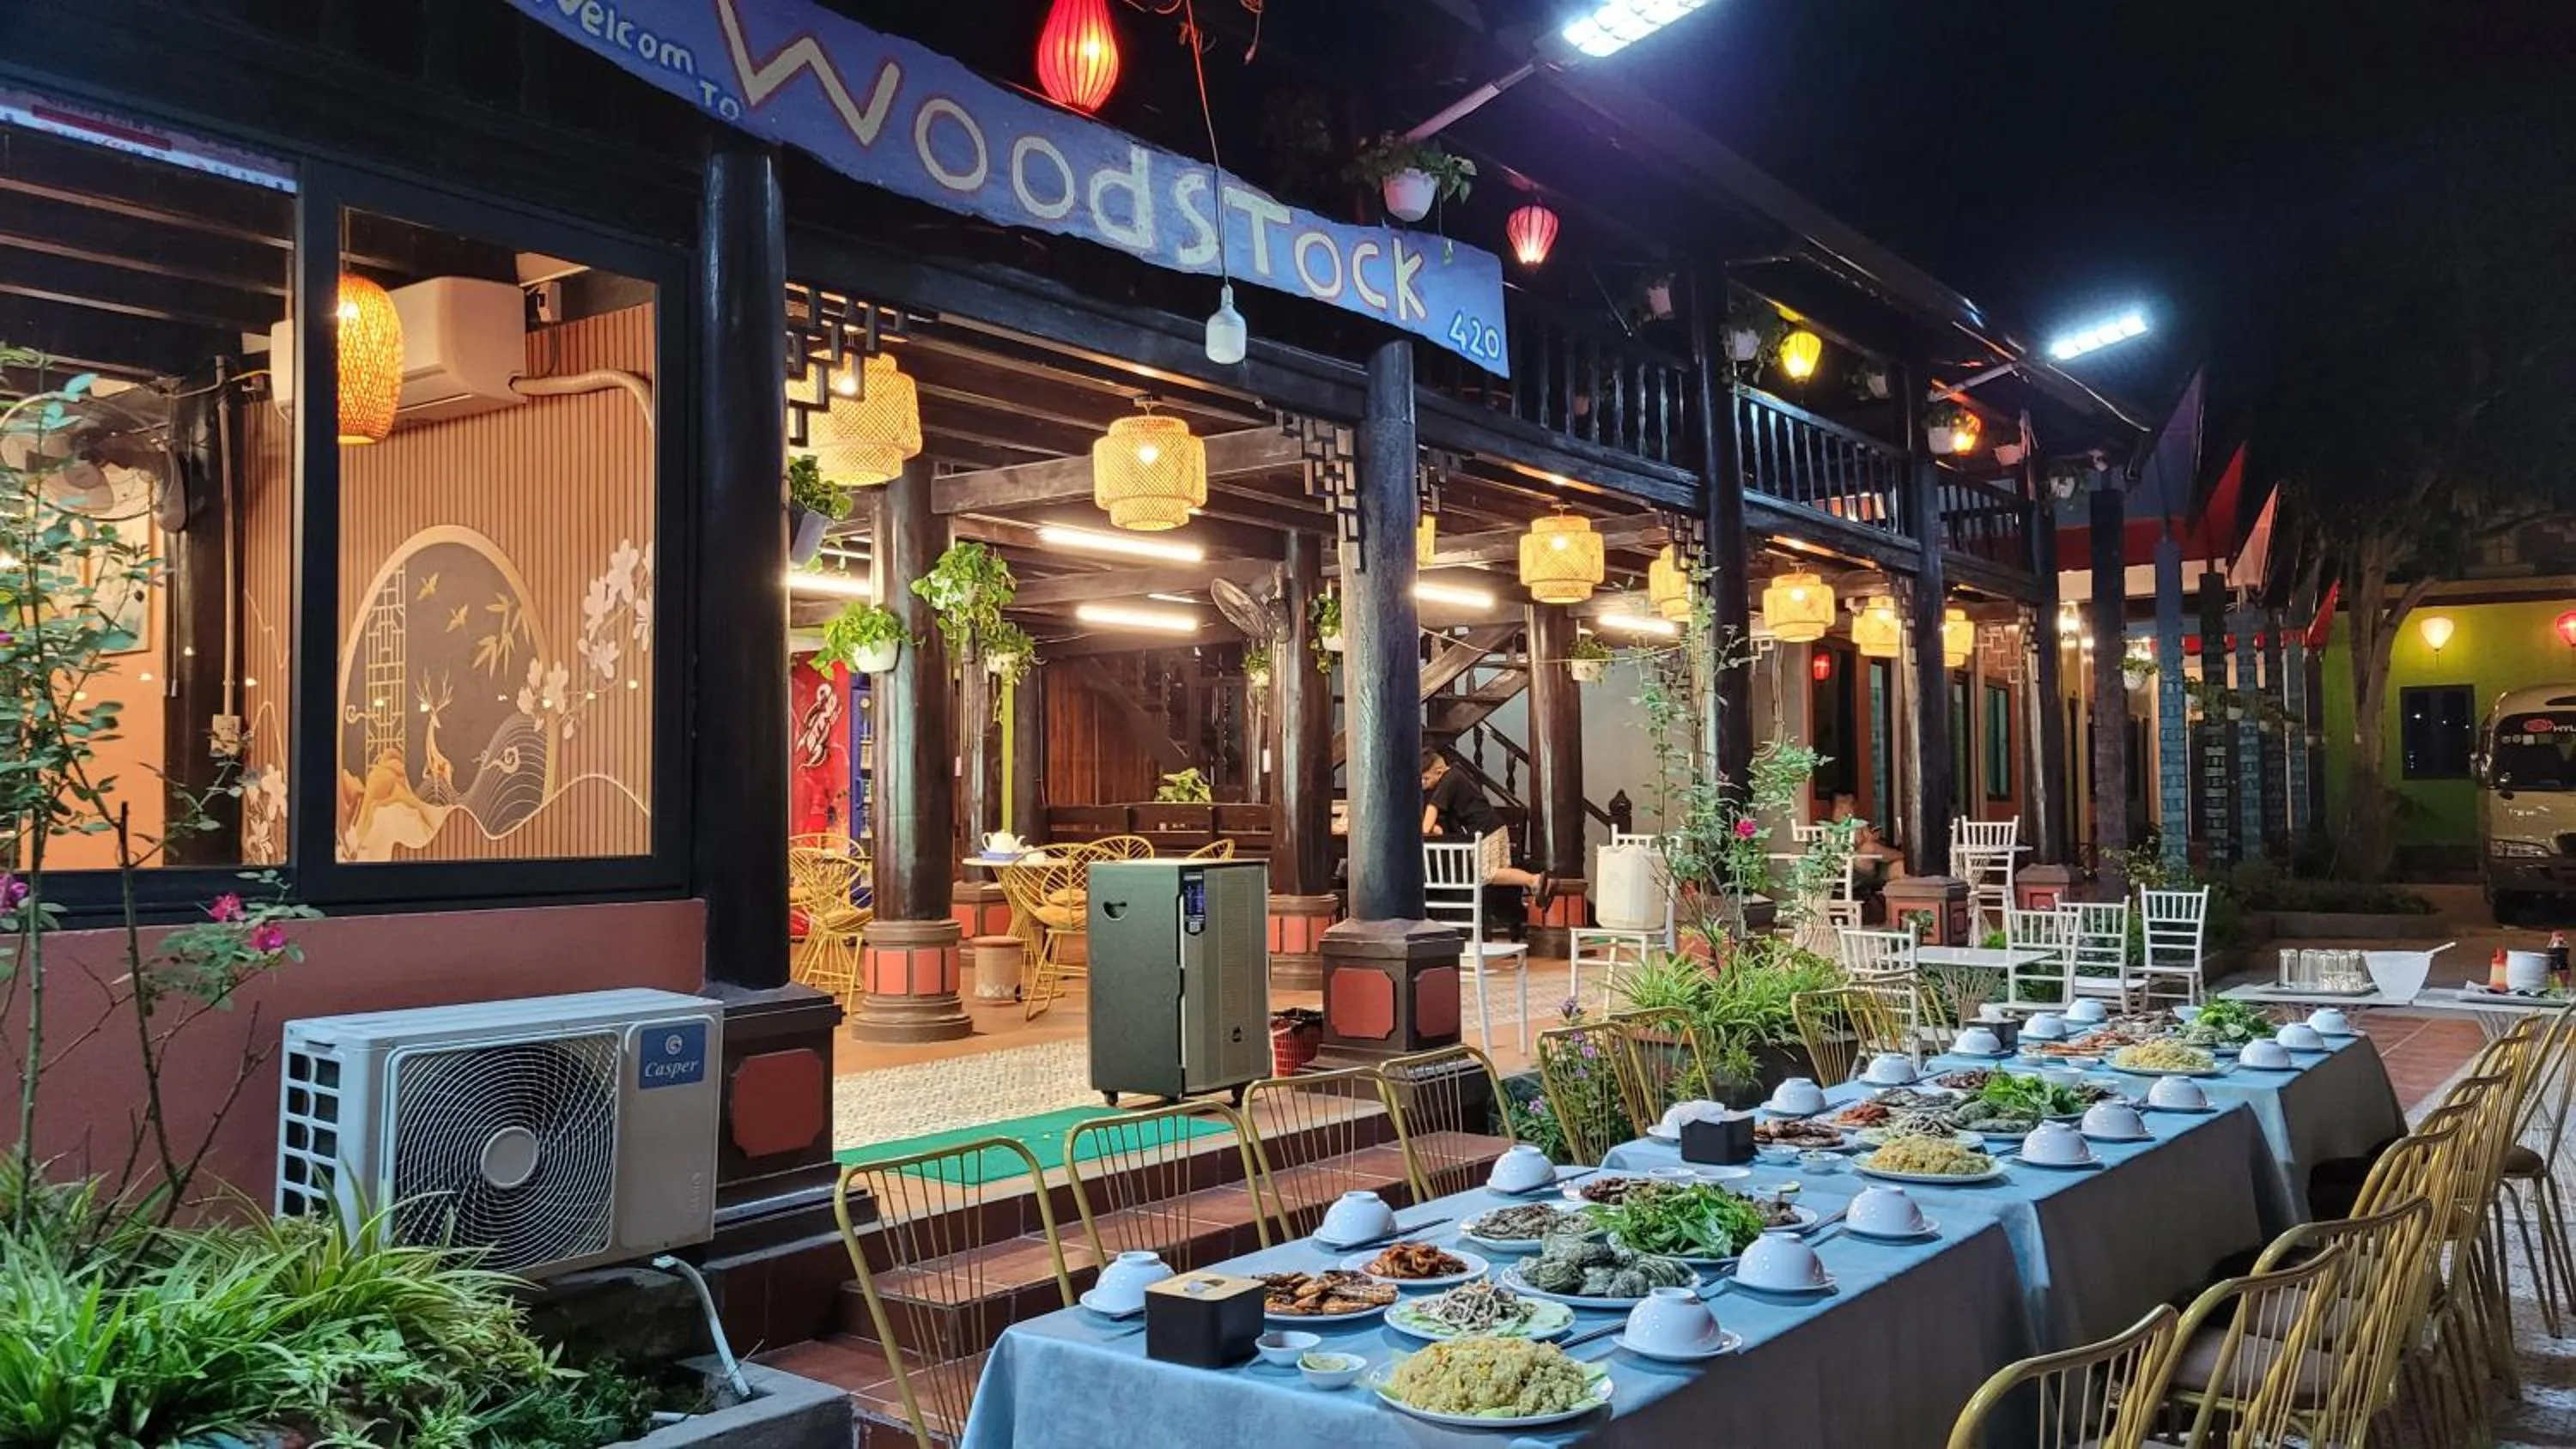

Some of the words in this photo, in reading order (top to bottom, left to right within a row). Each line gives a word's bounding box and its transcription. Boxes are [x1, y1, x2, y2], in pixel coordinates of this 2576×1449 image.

[535, 0, 693, 75] elcom
[1448, 312, 1501, 359] 420
[645, 1058, 699, 1079] Casper
